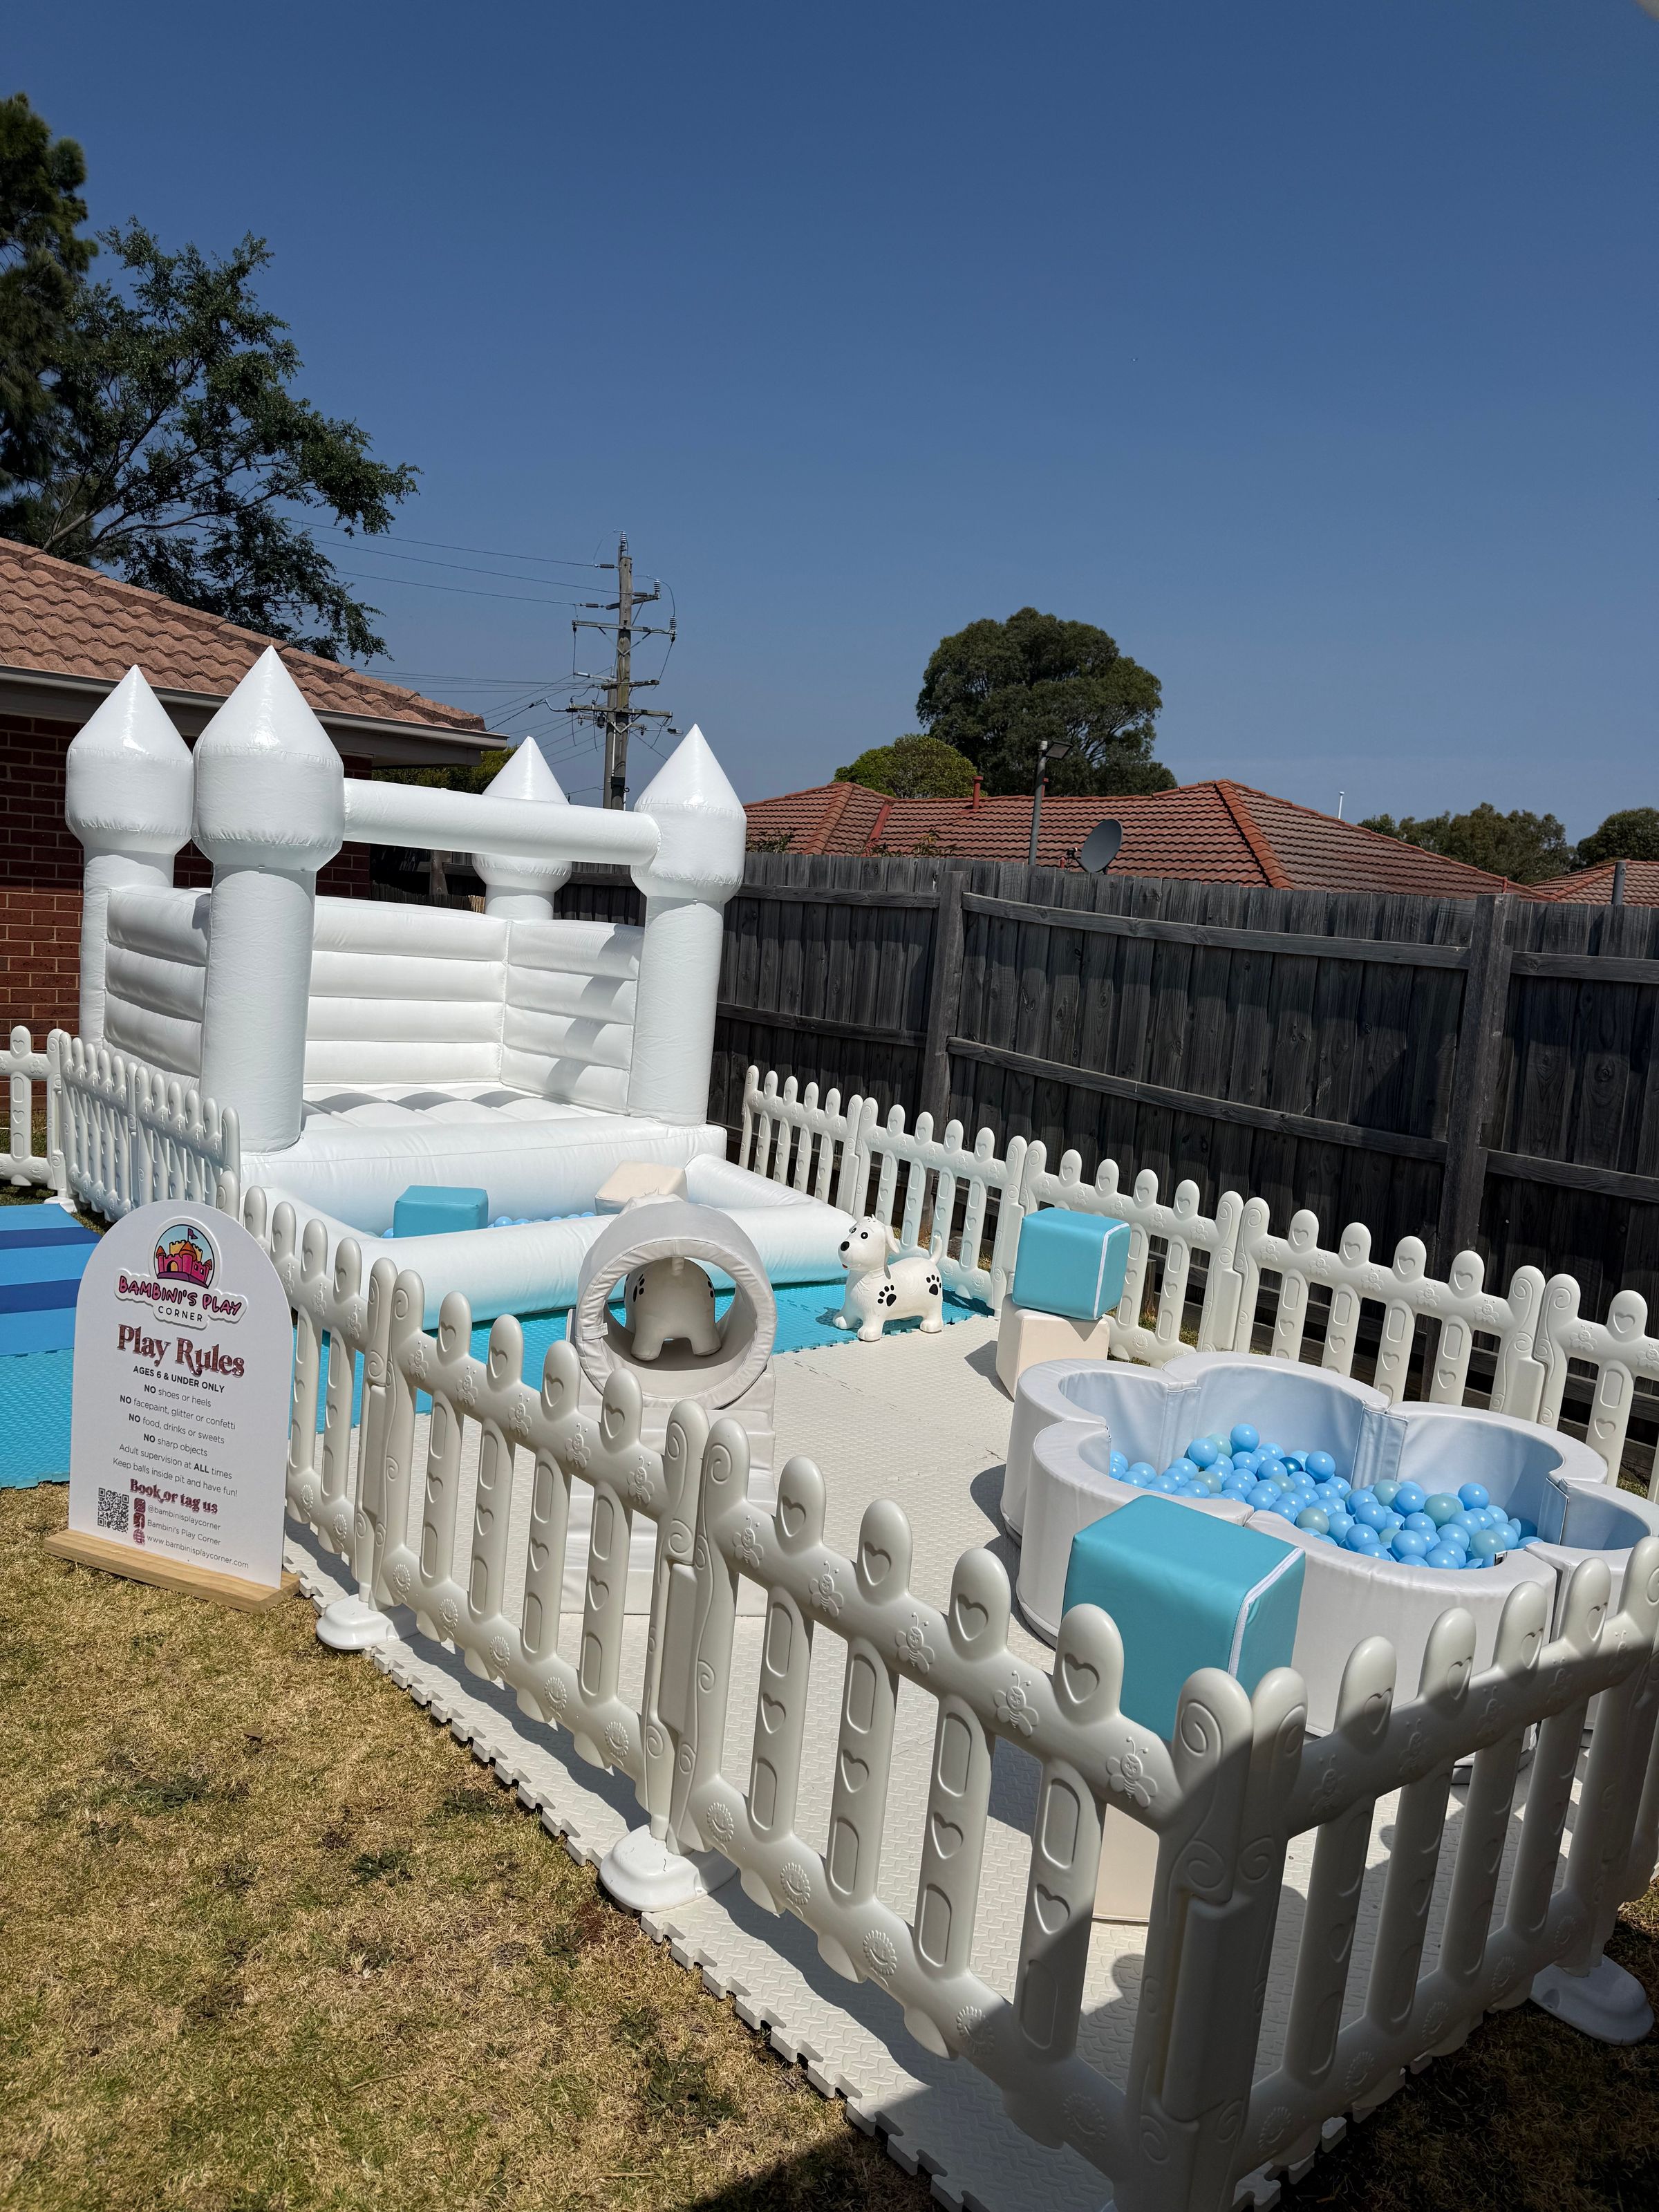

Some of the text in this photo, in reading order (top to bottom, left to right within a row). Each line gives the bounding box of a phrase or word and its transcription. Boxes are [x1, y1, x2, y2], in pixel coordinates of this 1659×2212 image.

[119, 1275, 242, 1316] BAMBINI'S PLAY
[158, 1306, 203, 1322] CORNER
[116, 1324, 245, 1378] Play Rules
[133, 1365, 154, 1377] AGES
[163, 1372, 169, 1380] &
[171, 1374, 200, 1388] UNDER
[201, 1381, 225, 1393] ONLY
[144, 1384, 156, 1394] NO
[158, 1388, 180, 1400] shoes
[191, 1395, 212, 1407] heels
[120, 1394, 132, 1404] NO
[133, 1398, 169, 1415] facepaint,
[171, 1407, 194, 1420] glitter
[205, 1417, 236, 1430] confetti
[129, 1413, 140, 1423] NO
[142, 1416, 162, 1429] food,
[163, 1422, 186, 1435] drinks
[198, 1431, 225, 1444] sweets
[143, 1433, 208, 1456] NO sharp objects
[112, 1457, 238, 1497] Keep balls inside pit and have fun!
[119, 1443, 232, 1480] Adult supervision at ALL times
[130, 1478, 218, 1515] Book or tag us
[147, 1504, 221, 1531] @bambinisplaycorner
[147, 1519, 221, 1546] Bambini's Play Corner
[147, 1535, 250, 1568] www.bambinisplaycorner.com
